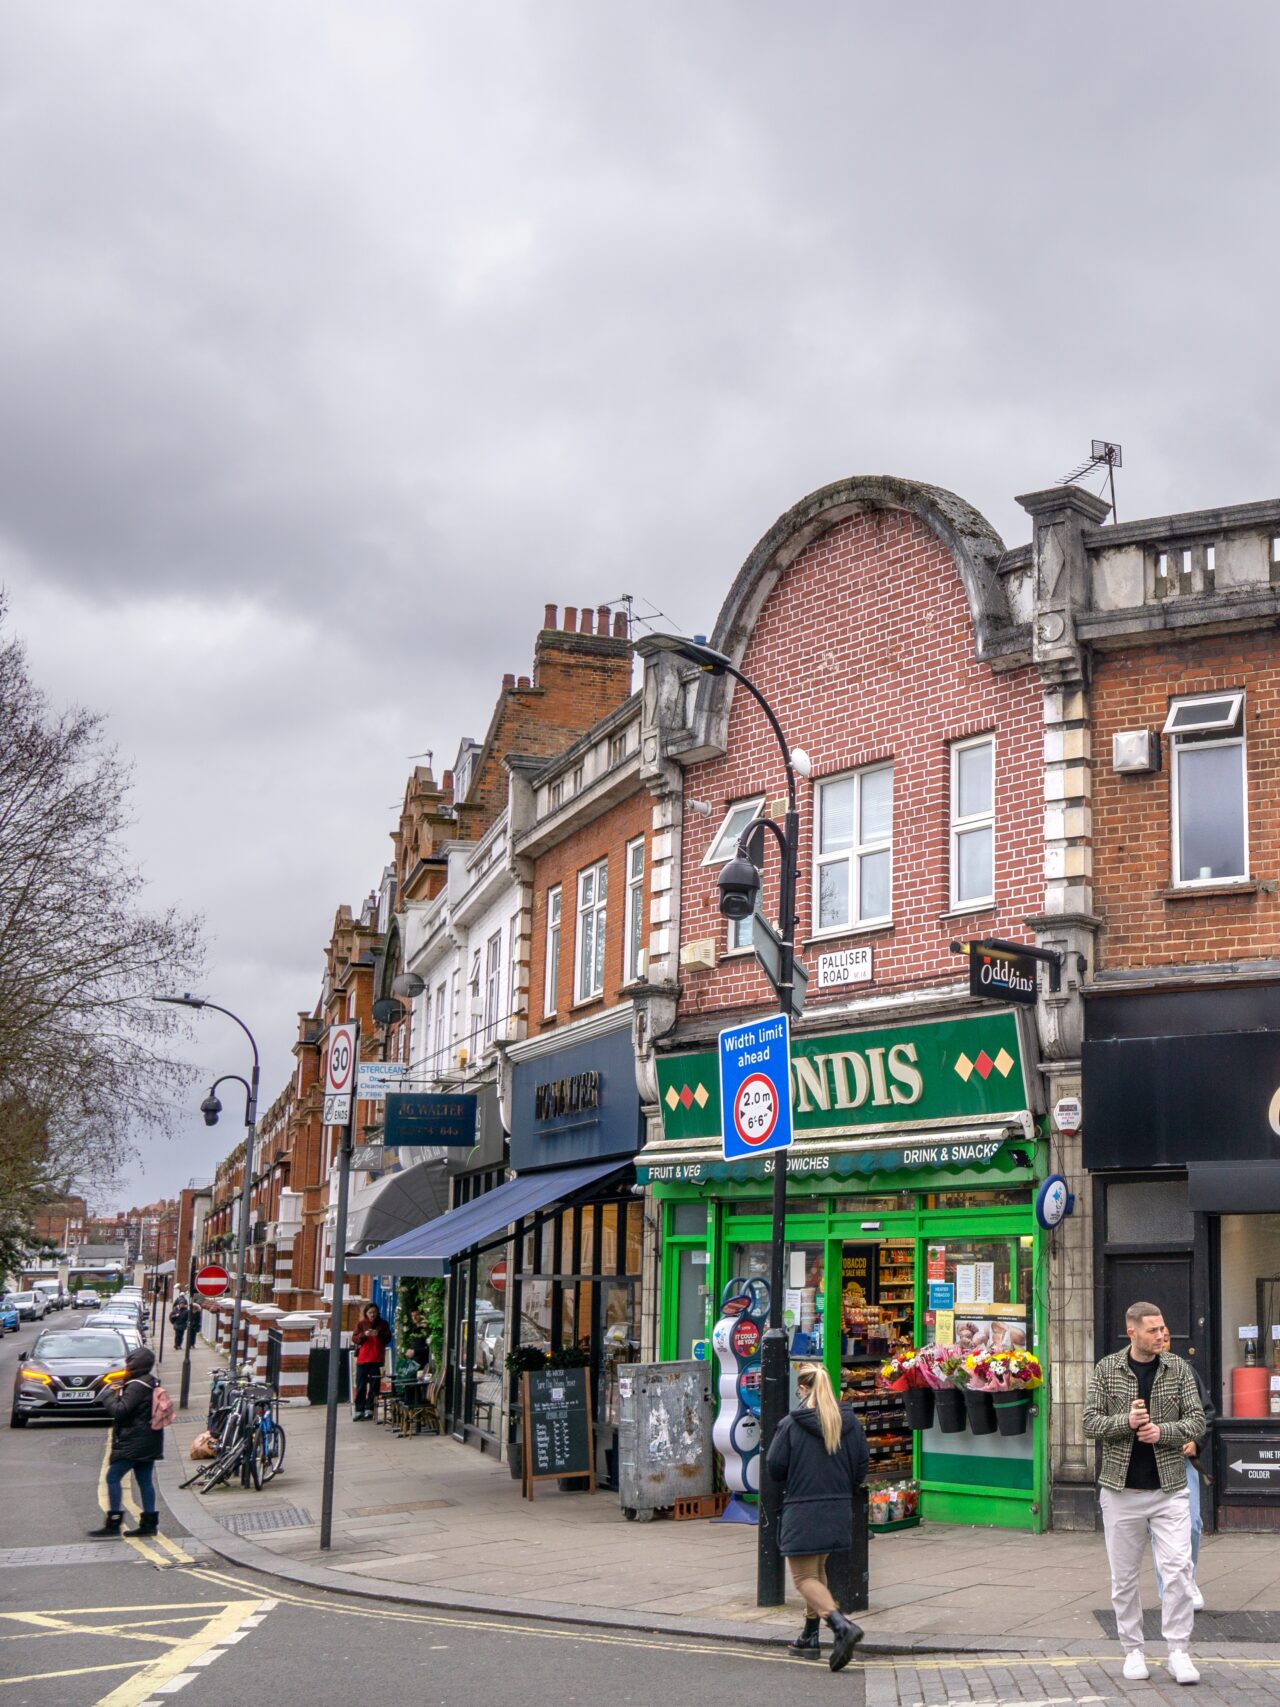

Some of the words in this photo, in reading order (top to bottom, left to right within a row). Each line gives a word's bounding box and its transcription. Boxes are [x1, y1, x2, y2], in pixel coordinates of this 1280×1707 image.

[822, 950, 868, 970] PALLISER
[823, 968, 849, 984] ROAD
[981, 957, 1034, 992] Oddbins
[724, 1031, 756, 1052] Width
[759, 1023, 783, 1042] limit
[333, 1047, 348, 1072] 30
[738, 1046, 770, 1067] ahead
[790, 1042, 923, 1113] NDIS
[743, 1092, 760, 1106] 2.0
[762, 1092, 771, 1102] m
[334, 1110, 348, 1120] ENDS
[904, 1147, 938, 1164] DRINK
[941, 1147, 949, 1161] &
[951, 1142, 999, 1160] SNACKS
[648, 1166, 673, 1179] FRUIT
[675, 1166, 682, 1178] &
[684, 1164, 701, 1178] VEG
[764, 1156, 830, 1173] SADWICHES
[842, 1258, 867, 1269] OBACCO
[1259, 1450, 1273, 1459] WINE
[1248, 1470, 1271, 1479] COLDER
